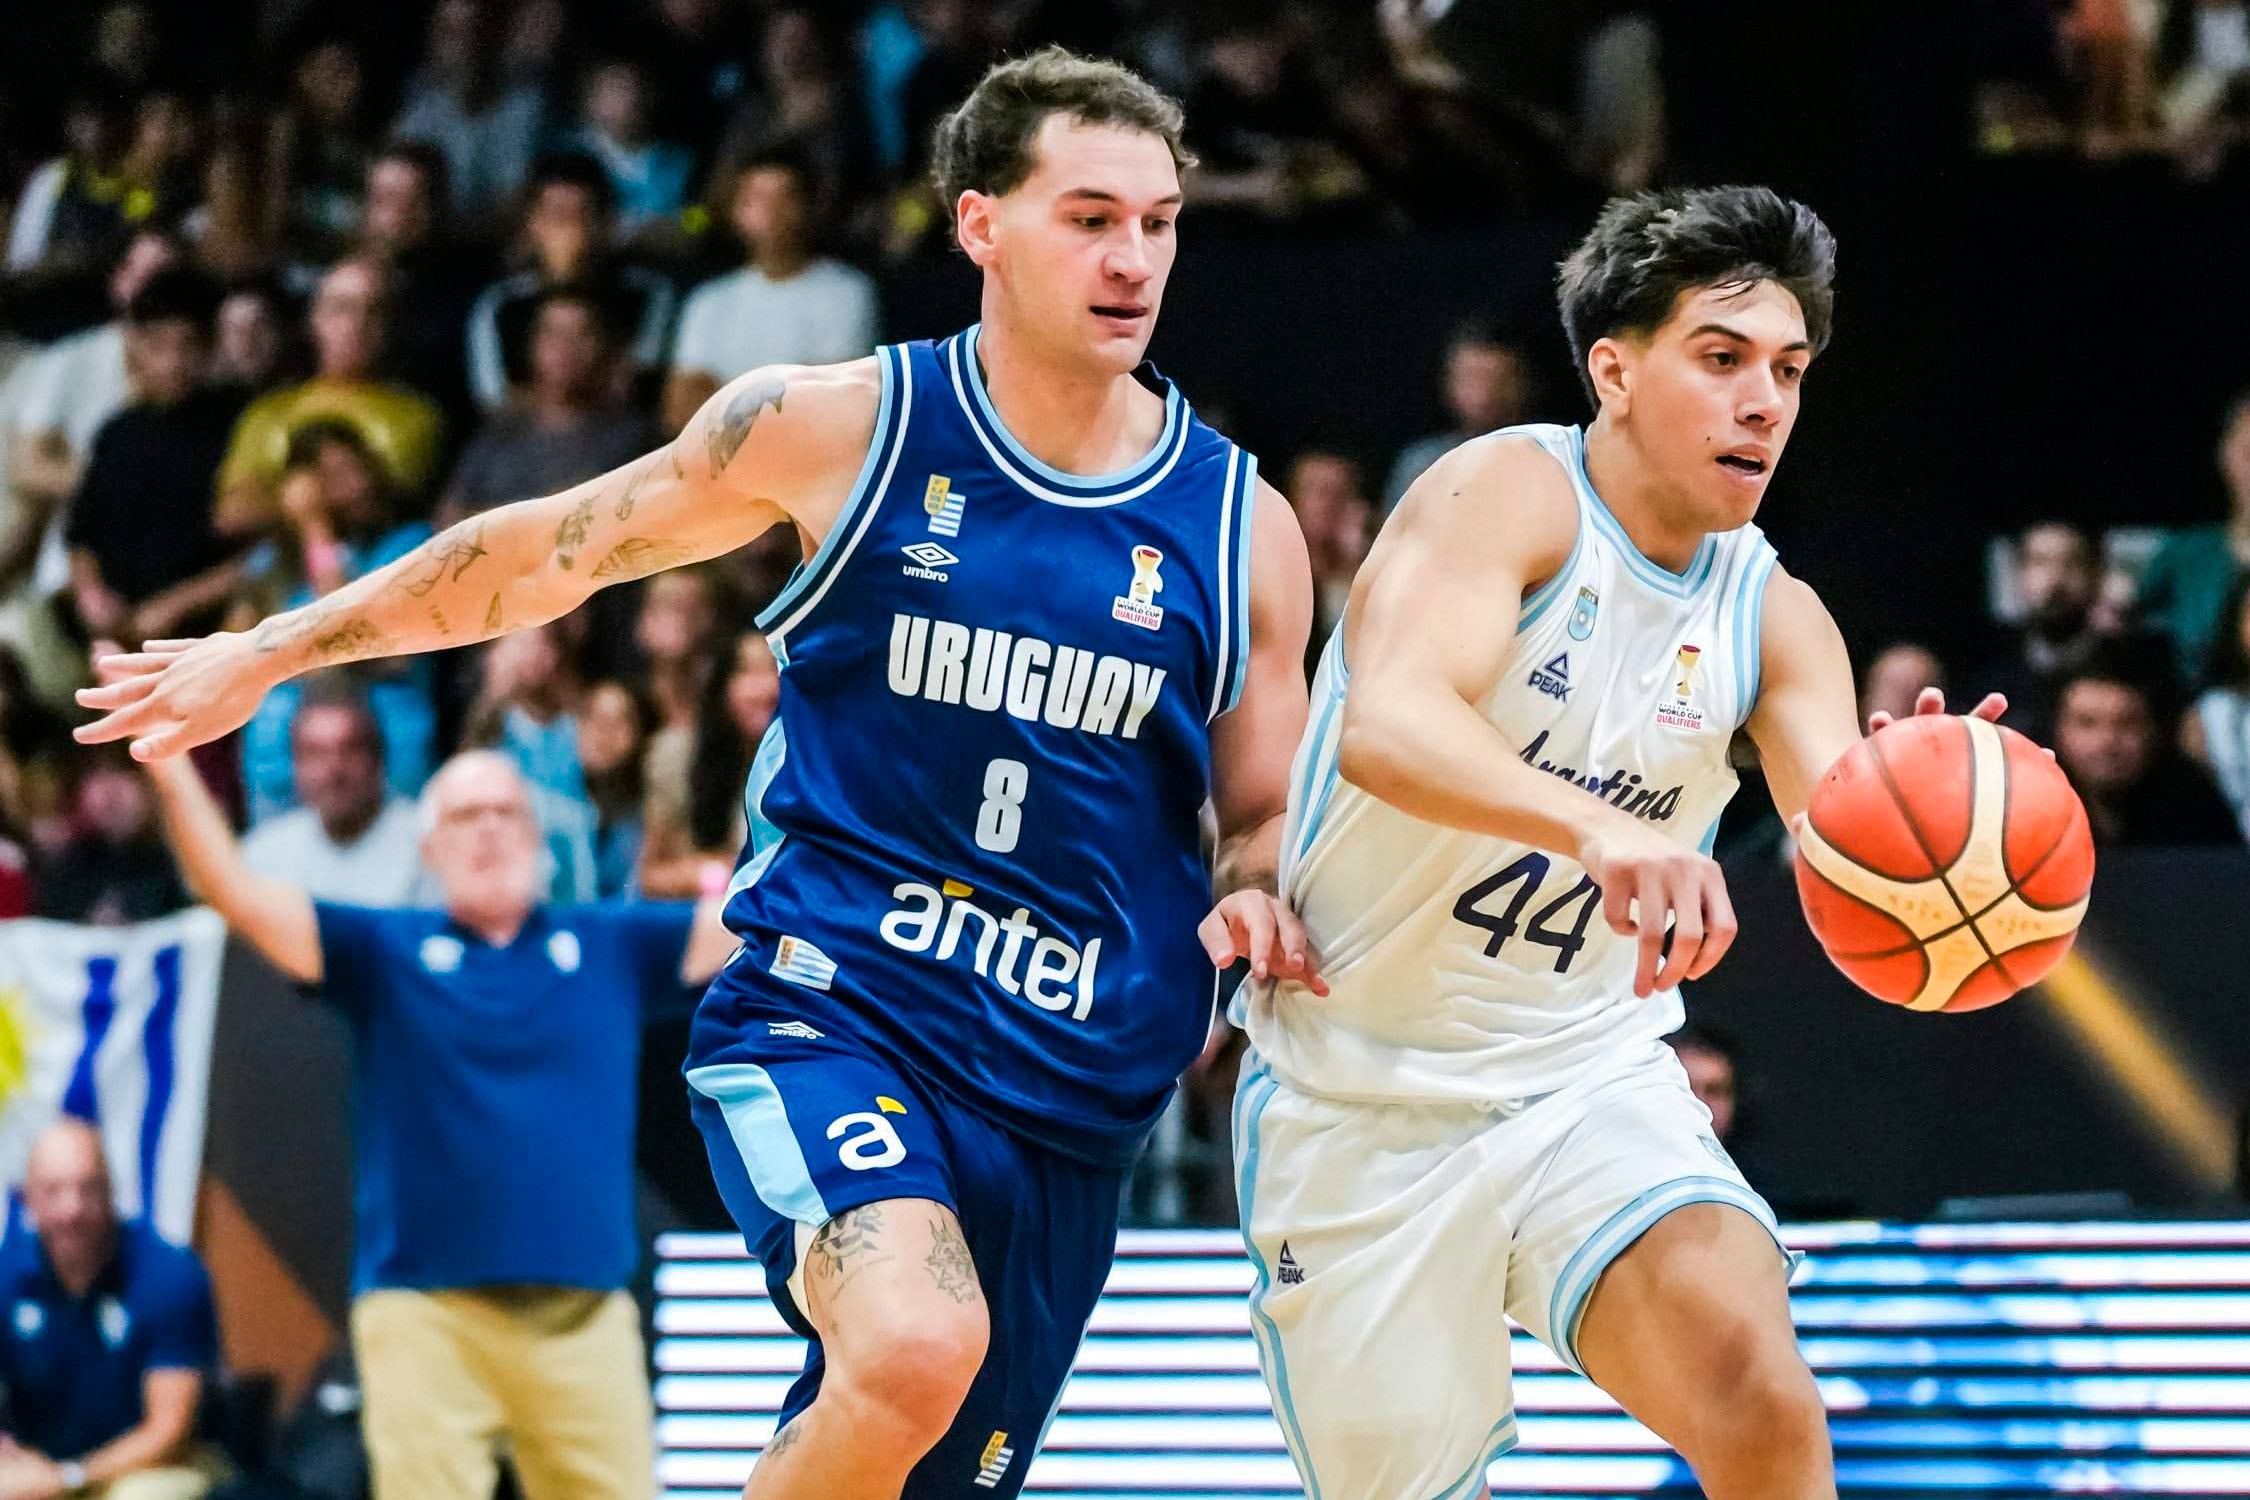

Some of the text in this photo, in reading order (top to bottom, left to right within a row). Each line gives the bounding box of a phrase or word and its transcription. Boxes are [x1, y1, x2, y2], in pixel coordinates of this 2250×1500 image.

[903, 565, 949, 582] umbro
[1117, 603, 1144, 614] WORLD
[1115, 609, 1159, 628] QUALIFIERS
[887, 613, 1167, 739] URUGUAY
[1528, 669, 1575, 703] PEAK
[1656, 713, 1702, 730] QUALIFIERS
[1659, 707, 1686, 718] WORLD
[975, 758, 1029, 853] 8
[1453, 851, 1603, 973] 44
[879, 879, 1102, 1021] antel
[769, 1028, 817, 1039] umbro
